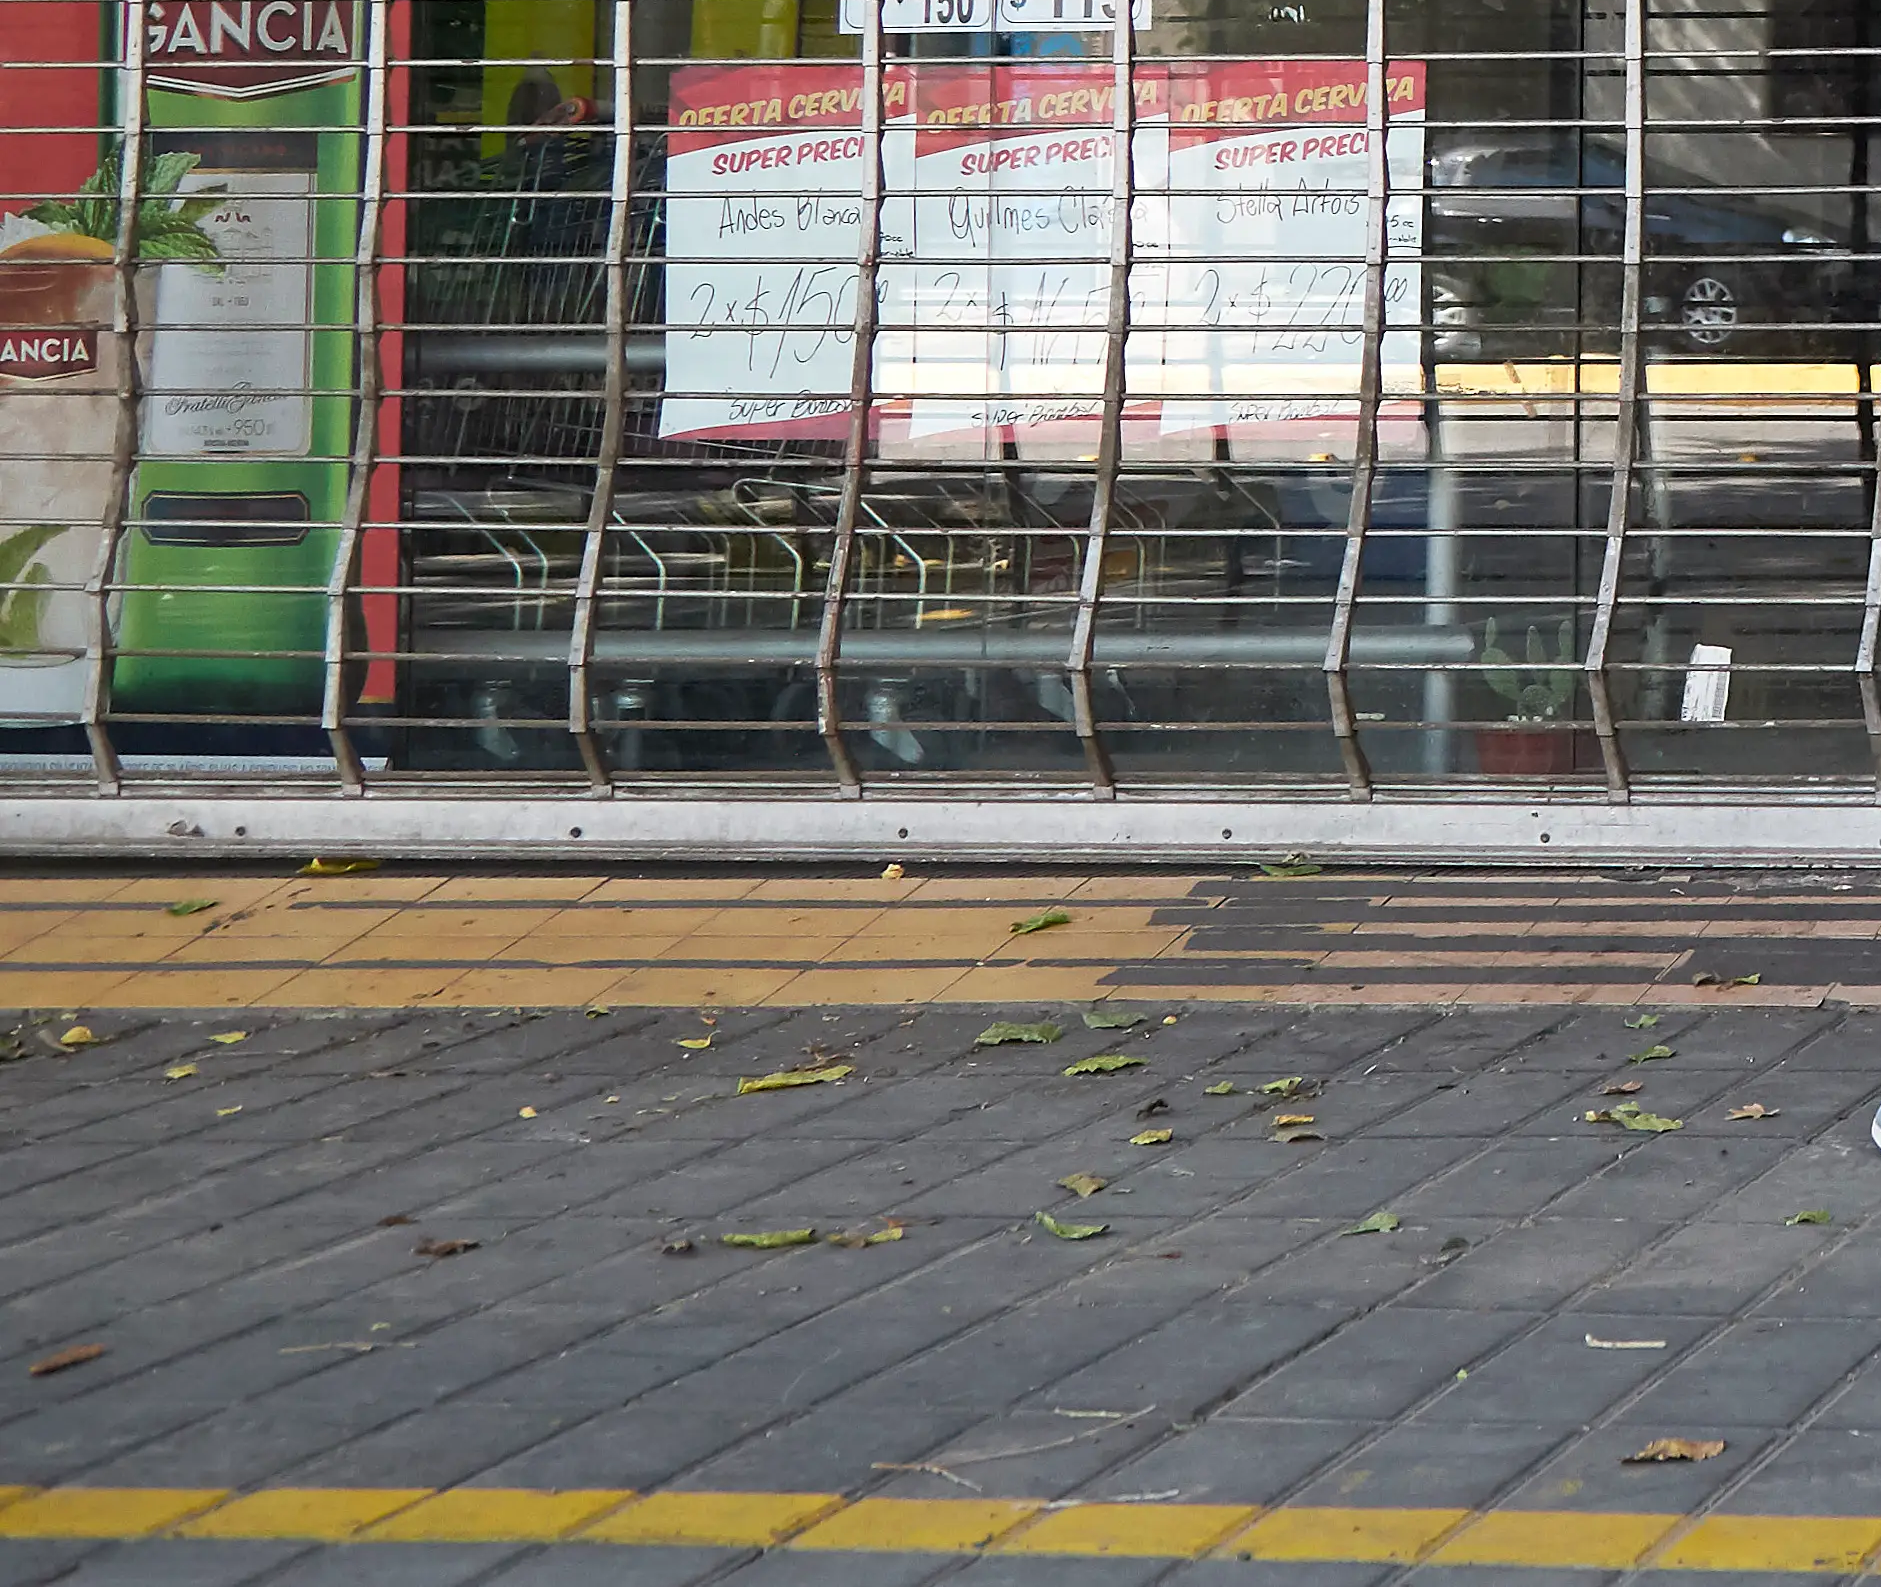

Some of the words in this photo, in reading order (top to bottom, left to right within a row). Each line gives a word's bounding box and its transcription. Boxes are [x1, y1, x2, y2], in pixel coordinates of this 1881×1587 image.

[146, 0, 348, 55] GANCIA
[680, 96, 783, 128] OFERTA
[787, 81, 905, 119] CERVA
[1040, 79, 1158, 119] CERVA
[1181, 92, 1287, 124] OFERTA
[1294, 76, 1414, 115] CERVZA
[711, 140, 798, 176] SUPER
[797, 135, 864, 167] PRECI
[960, 144, 1039, 176] SUPER
[1044, 135, 1115, 167] PRECI
[1214, 140, 1298, 171] SUPER
[1301, 131, 1369, 161] PRECI
[0, 336, 90, 363] ANCIA
